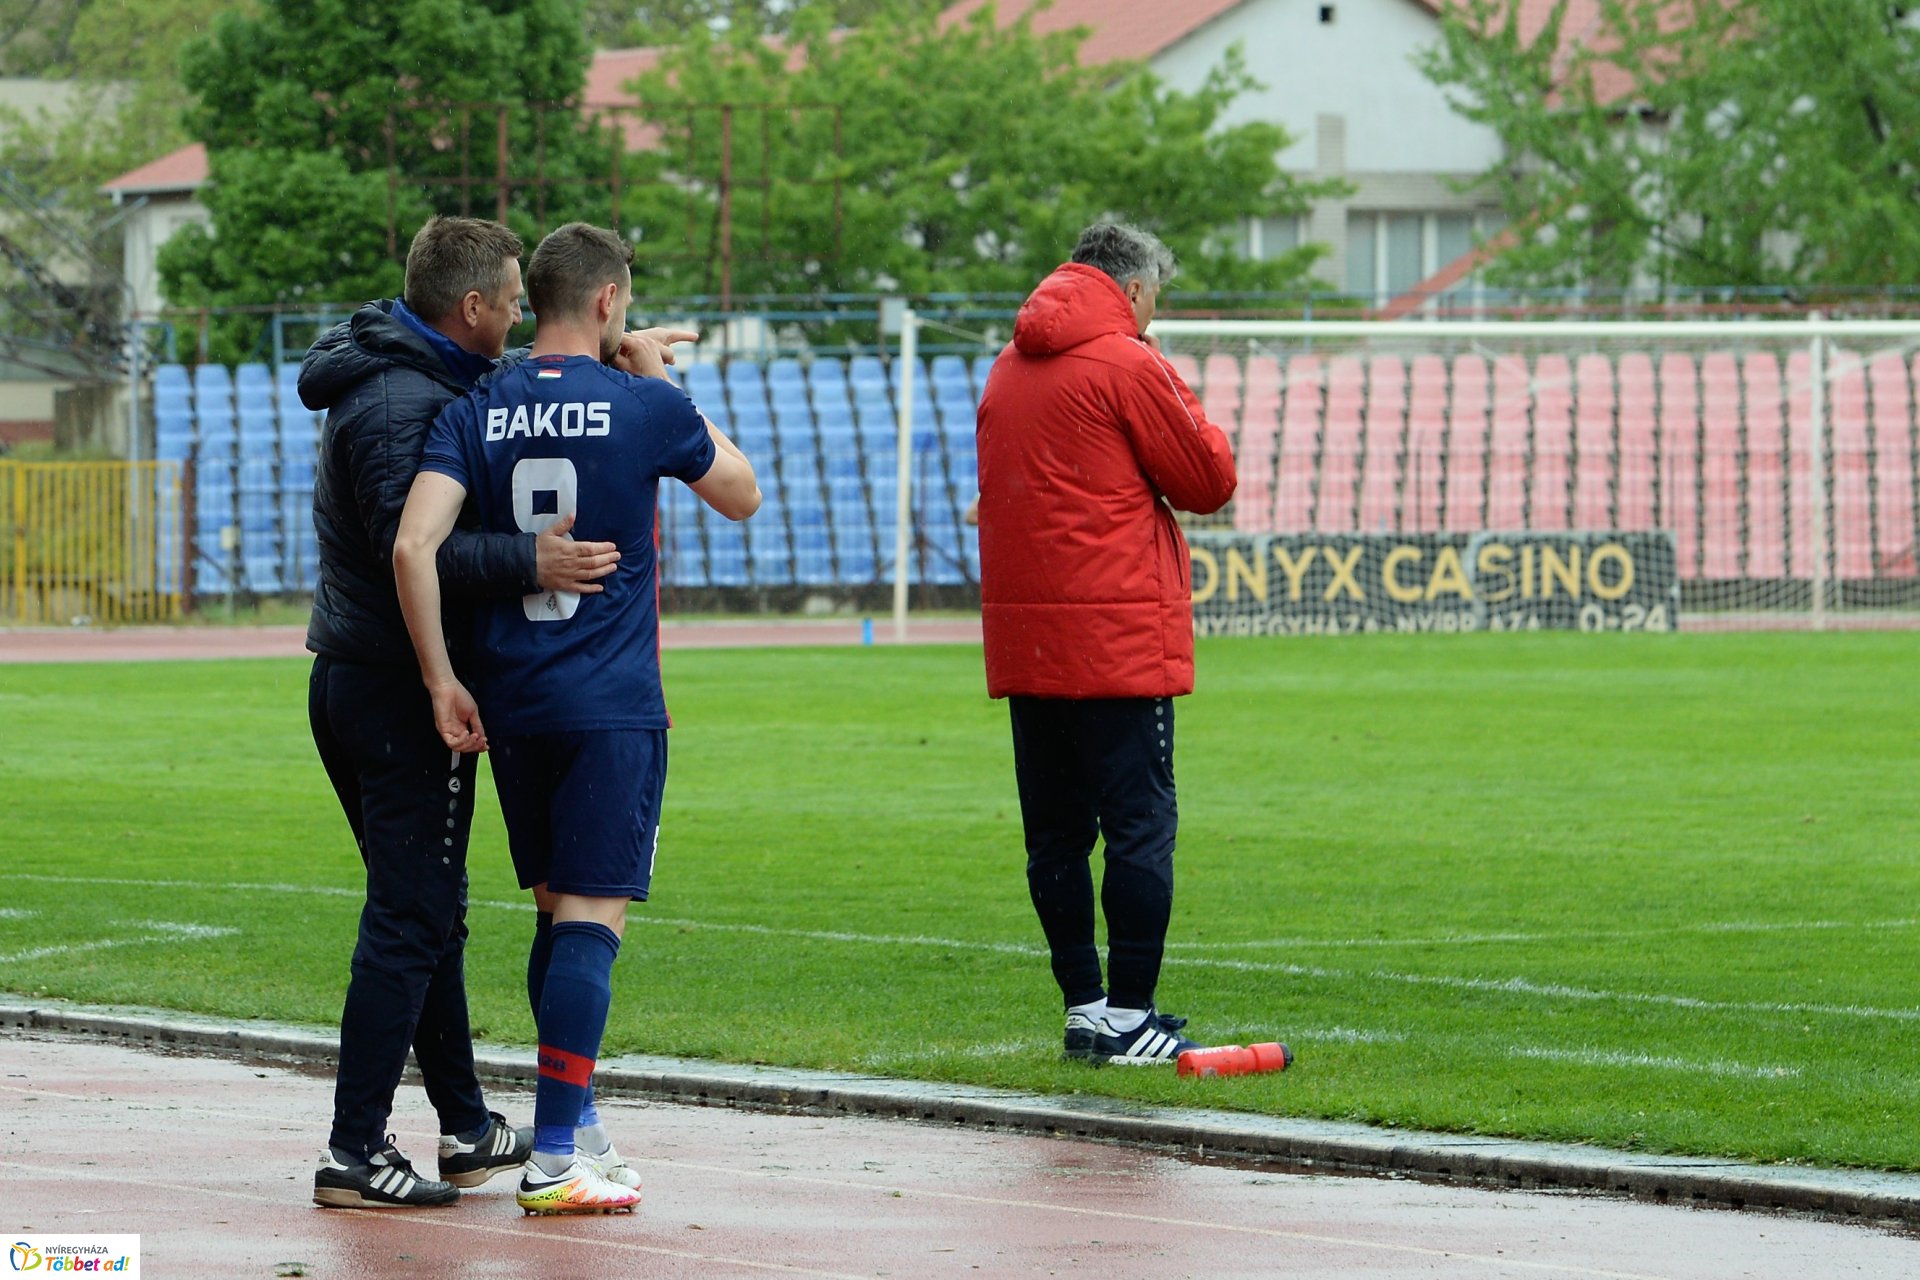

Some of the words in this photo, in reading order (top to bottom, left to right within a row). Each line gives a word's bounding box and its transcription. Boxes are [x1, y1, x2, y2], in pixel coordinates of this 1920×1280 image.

[486, 402, 611, 441] BAKOS
[1190, 545, 1366, 603] ONYX
[1382, 543, 1634, 602] CASINO
